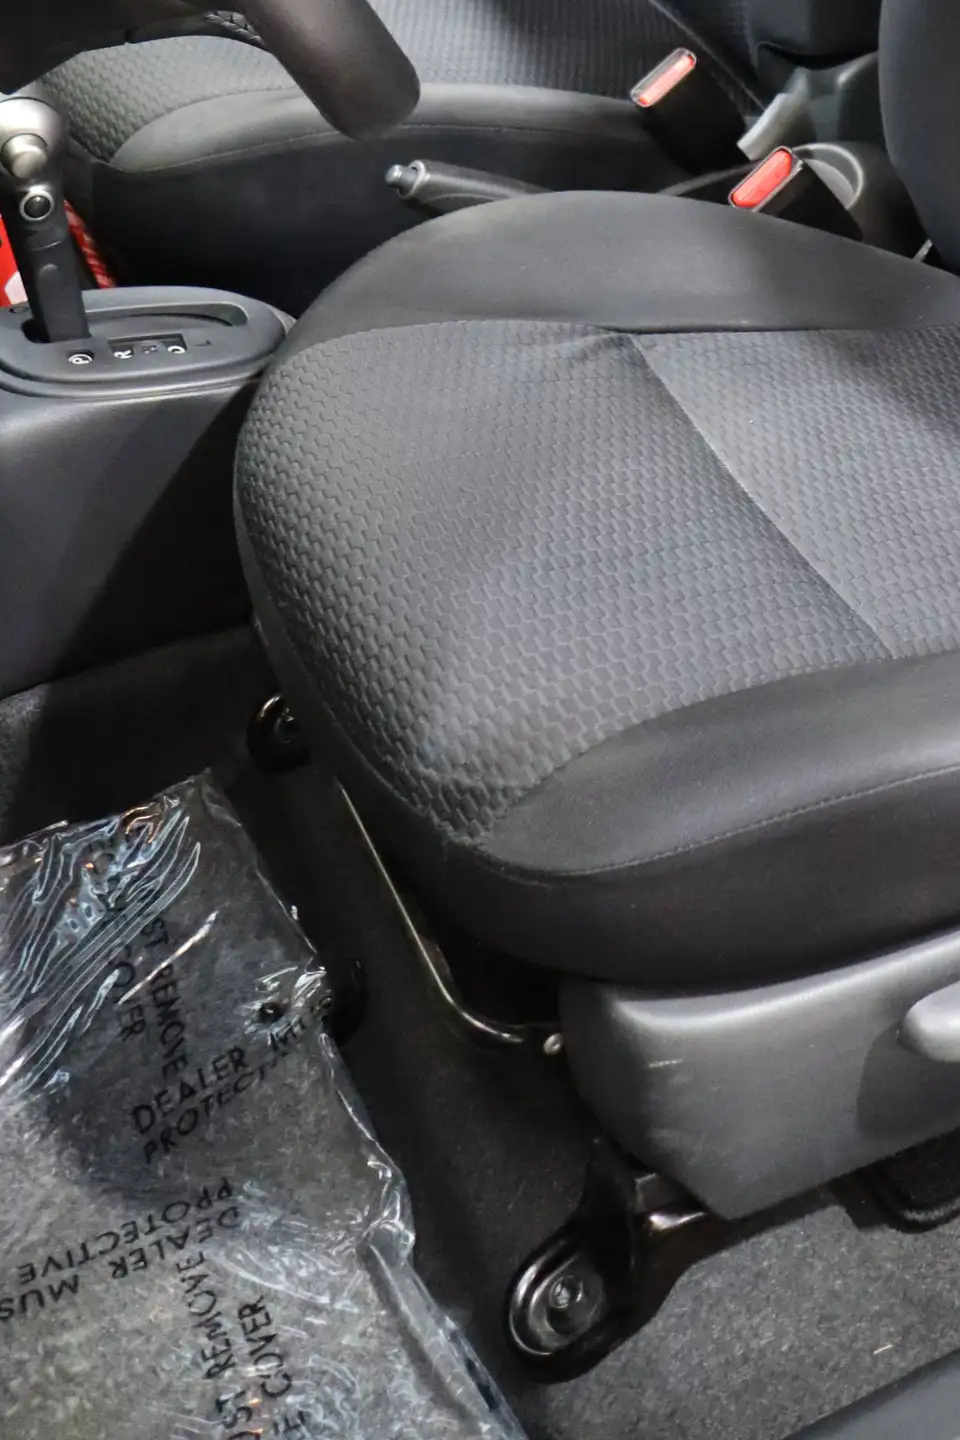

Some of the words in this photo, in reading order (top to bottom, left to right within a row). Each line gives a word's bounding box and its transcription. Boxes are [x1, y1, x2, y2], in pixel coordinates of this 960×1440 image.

[132, 1045, 248, 1135] DEALER
[17, 1176, 233, 1286] PROTECTIVE
[107, 1206, 241, 1280] DEALER
[175, 1251, 236, 1380] REMOVE
